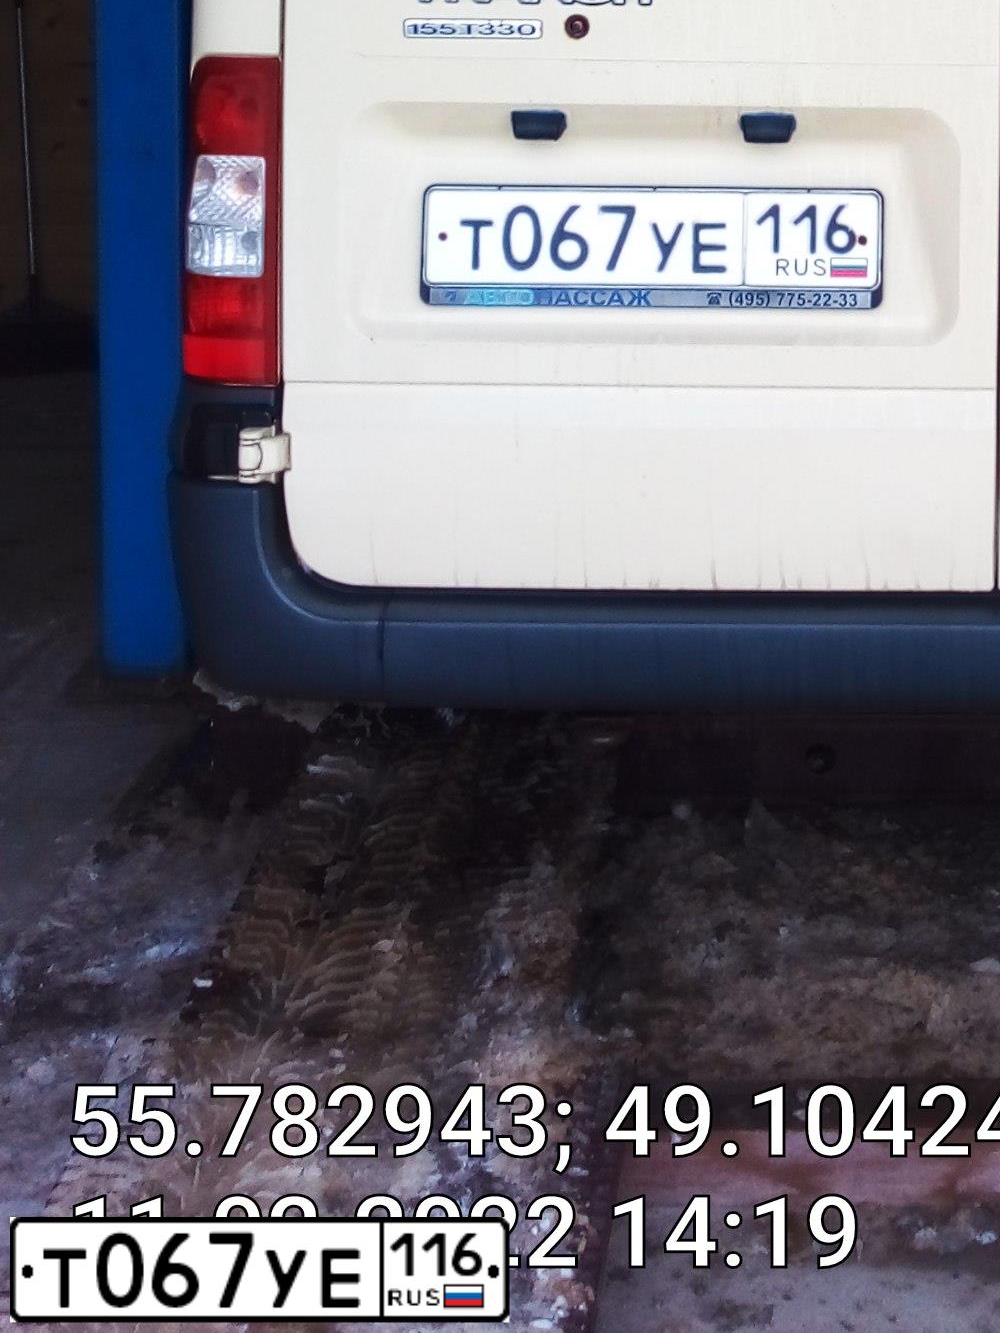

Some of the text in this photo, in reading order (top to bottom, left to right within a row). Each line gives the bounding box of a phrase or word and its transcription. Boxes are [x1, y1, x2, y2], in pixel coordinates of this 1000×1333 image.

[459, 204, 856, 274] Т067УЕ 116
[775, 258, 827, 277] RUS
[728, 292, 771, 308] (495)
[776, 292, 858, 308] 775-22-33
